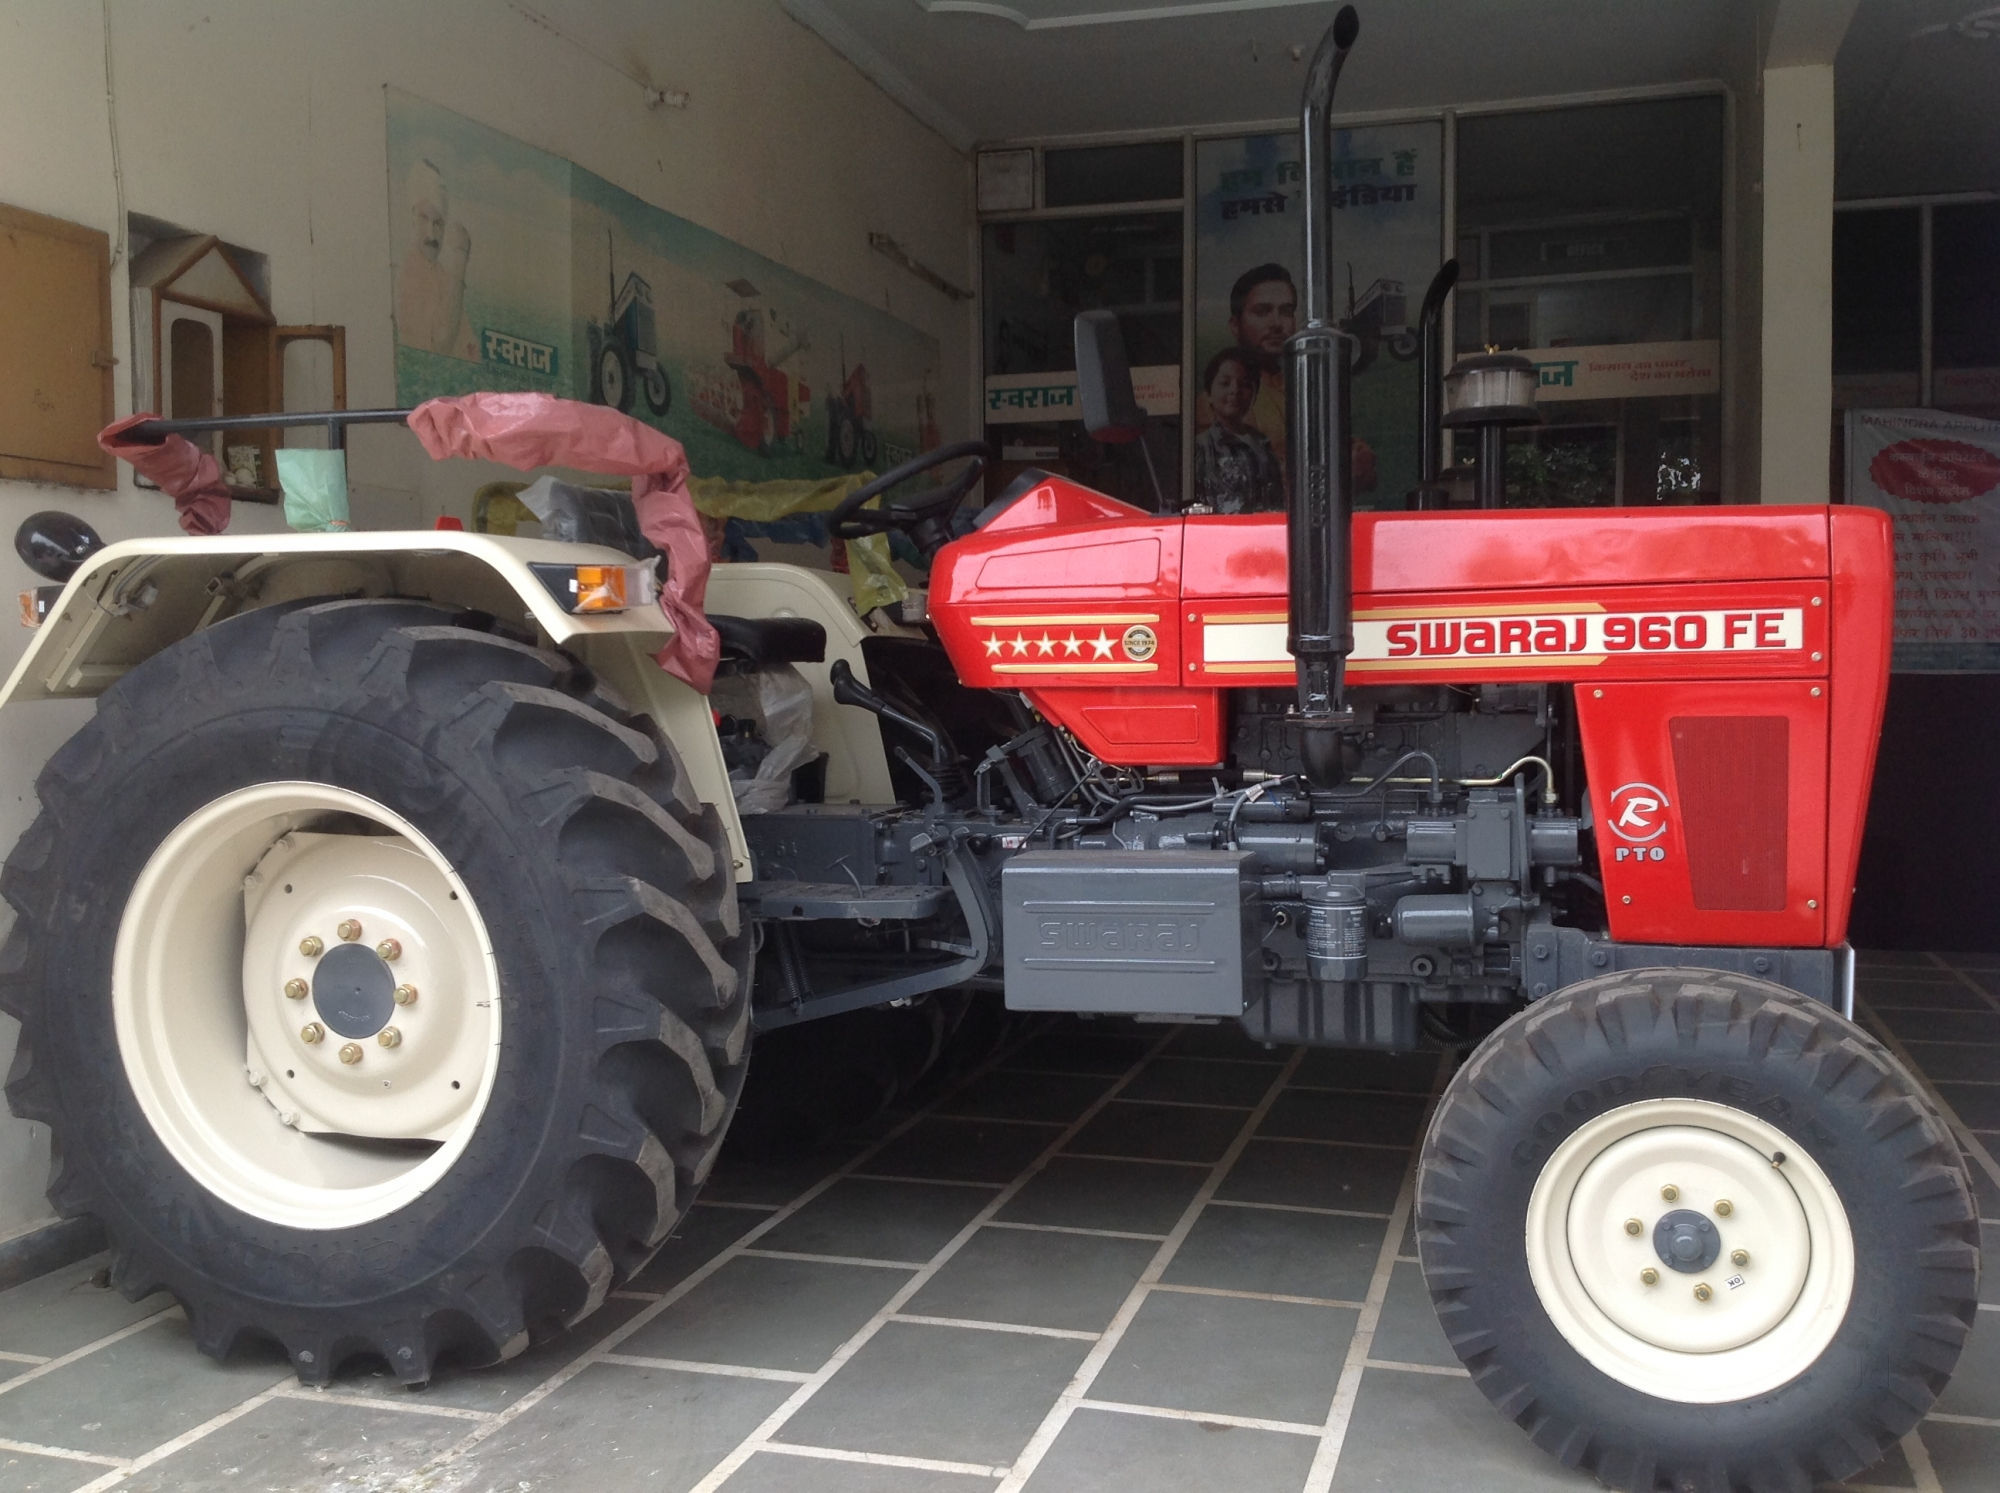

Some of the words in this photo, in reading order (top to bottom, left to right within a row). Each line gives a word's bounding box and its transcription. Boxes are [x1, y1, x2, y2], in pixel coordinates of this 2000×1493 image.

[485, 329, 554, 374] स्वराज
[988, 385, 1077, 411] स्वराज
[1860, 414, 1939, 429] MAHINDRA
[1603, 615, 1707, 650] 960
[1724, 613, 1786, 648] FE
[1615, 846, 1665, 862] PTO
[1727, 1276, 1741, 1287] OK
